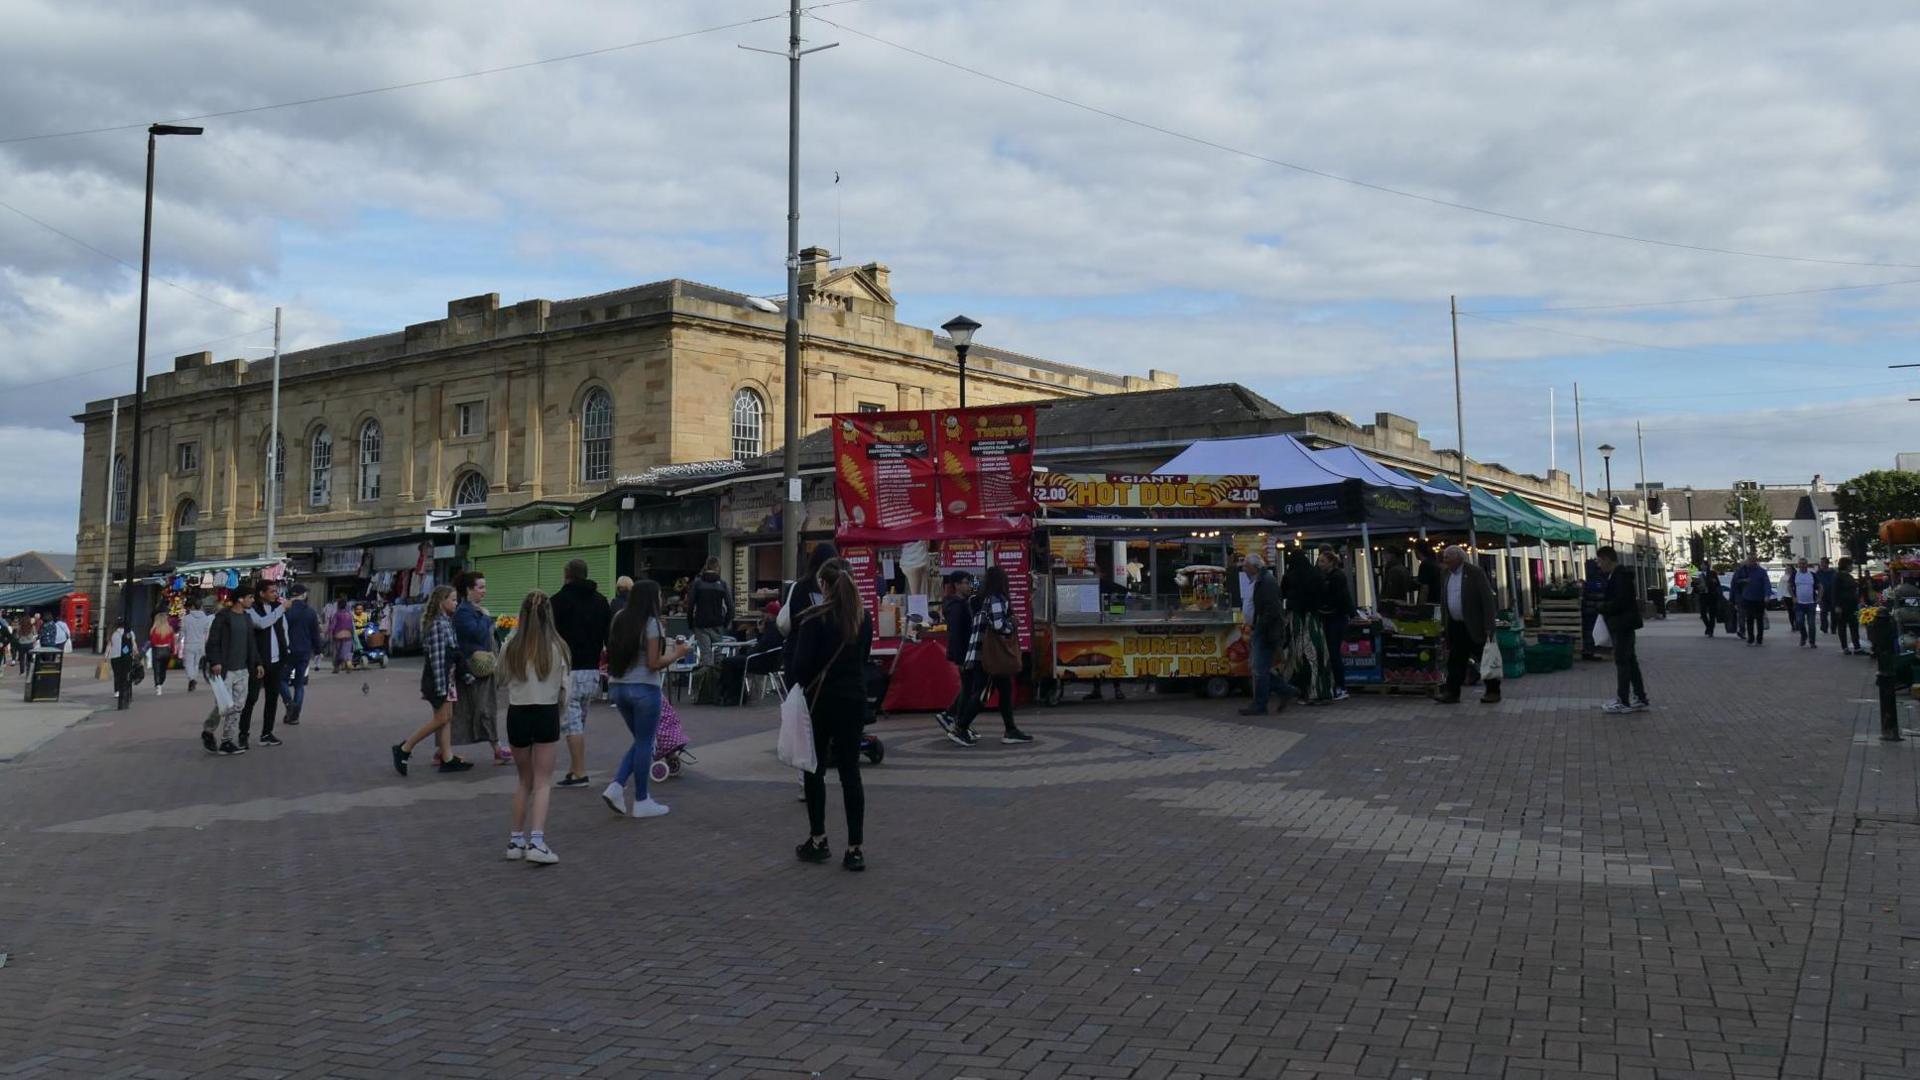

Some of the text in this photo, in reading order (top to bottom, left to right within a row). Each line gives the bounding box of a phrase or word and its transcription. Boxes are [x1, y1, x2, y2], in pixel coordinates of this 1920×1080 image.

[1119, 475, 1174, 483] GIANT
[1034, 488, 1067, 501] £2.00
[1076, 482, 1132, 506] HOT
[1139, 482, 1214, 506] DOGS
[1228, 488, 1259, 501] £2.00
[998, 551, 1023, 559] MENU
[1123, 636, 1217, 655] BURGERS
[1110, 657, 1232, 676] & HOT DOGS
